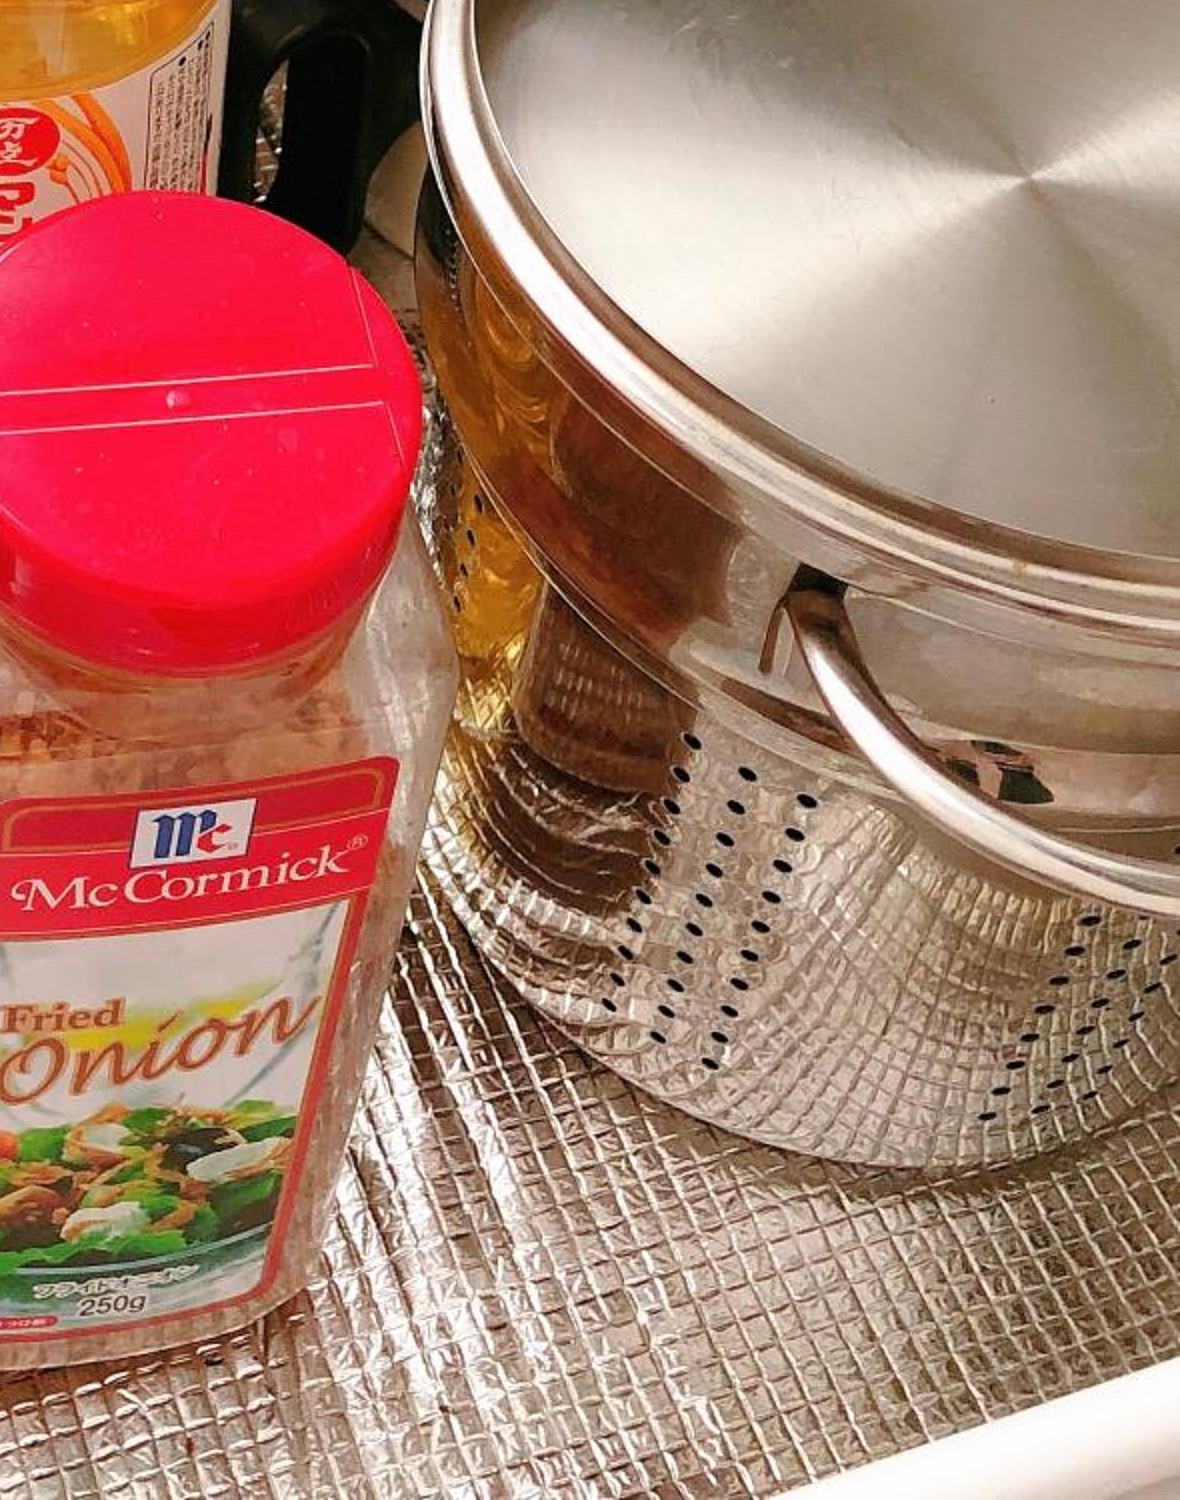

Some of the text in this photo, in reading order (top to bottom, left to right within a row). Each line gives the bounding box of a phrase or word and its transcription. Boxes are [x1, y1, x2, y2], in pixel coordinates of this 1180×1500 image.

[10, 844, 351, 913] McCormick
[0, 999, 125, 1035] Fried
[78, 1293, 148, 1318] 250g
